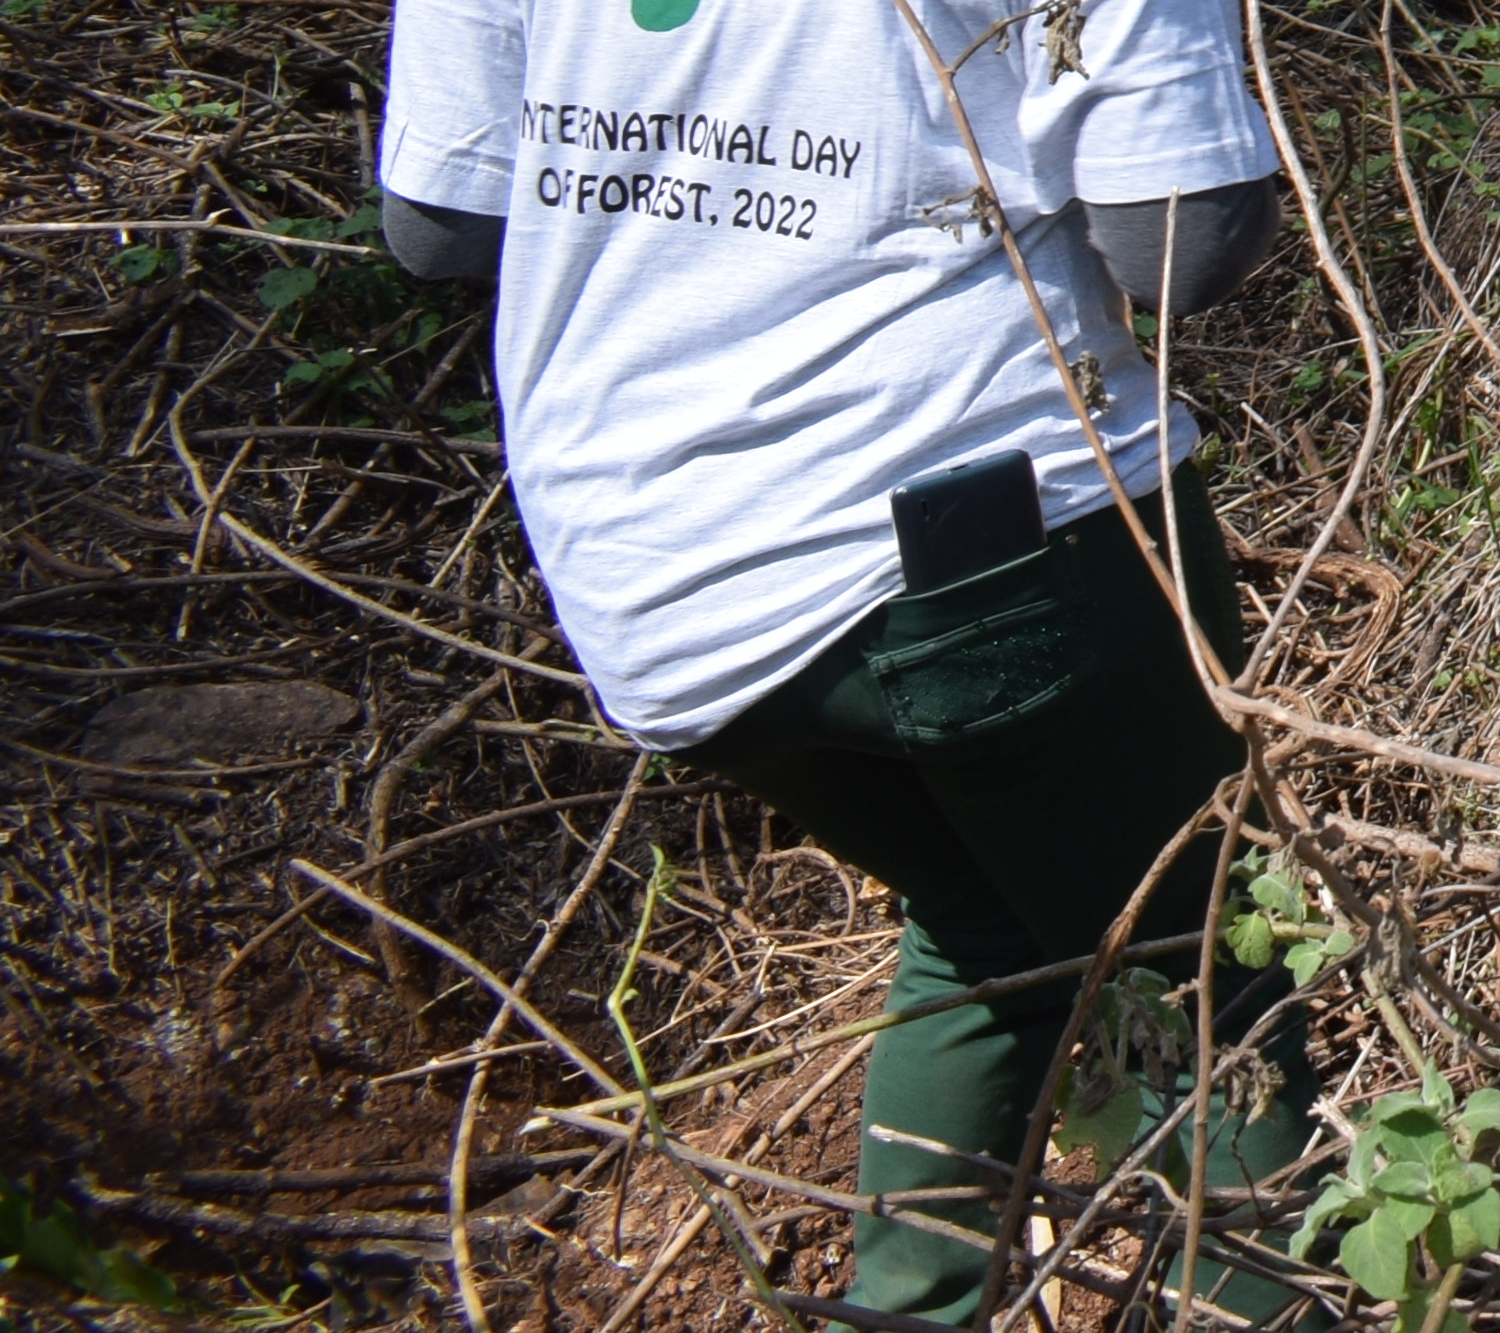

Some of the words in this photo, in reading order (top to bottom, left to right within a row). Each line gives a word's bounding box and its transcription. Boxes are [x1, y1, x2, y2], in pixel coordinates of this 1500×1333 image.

[521, 98, 777, 166] NTERNATIONAL
[791, 129, 862, 179] DAY
[576, 173, 719, 227] FOREST,
[732, 188, 817, 240] 2022
